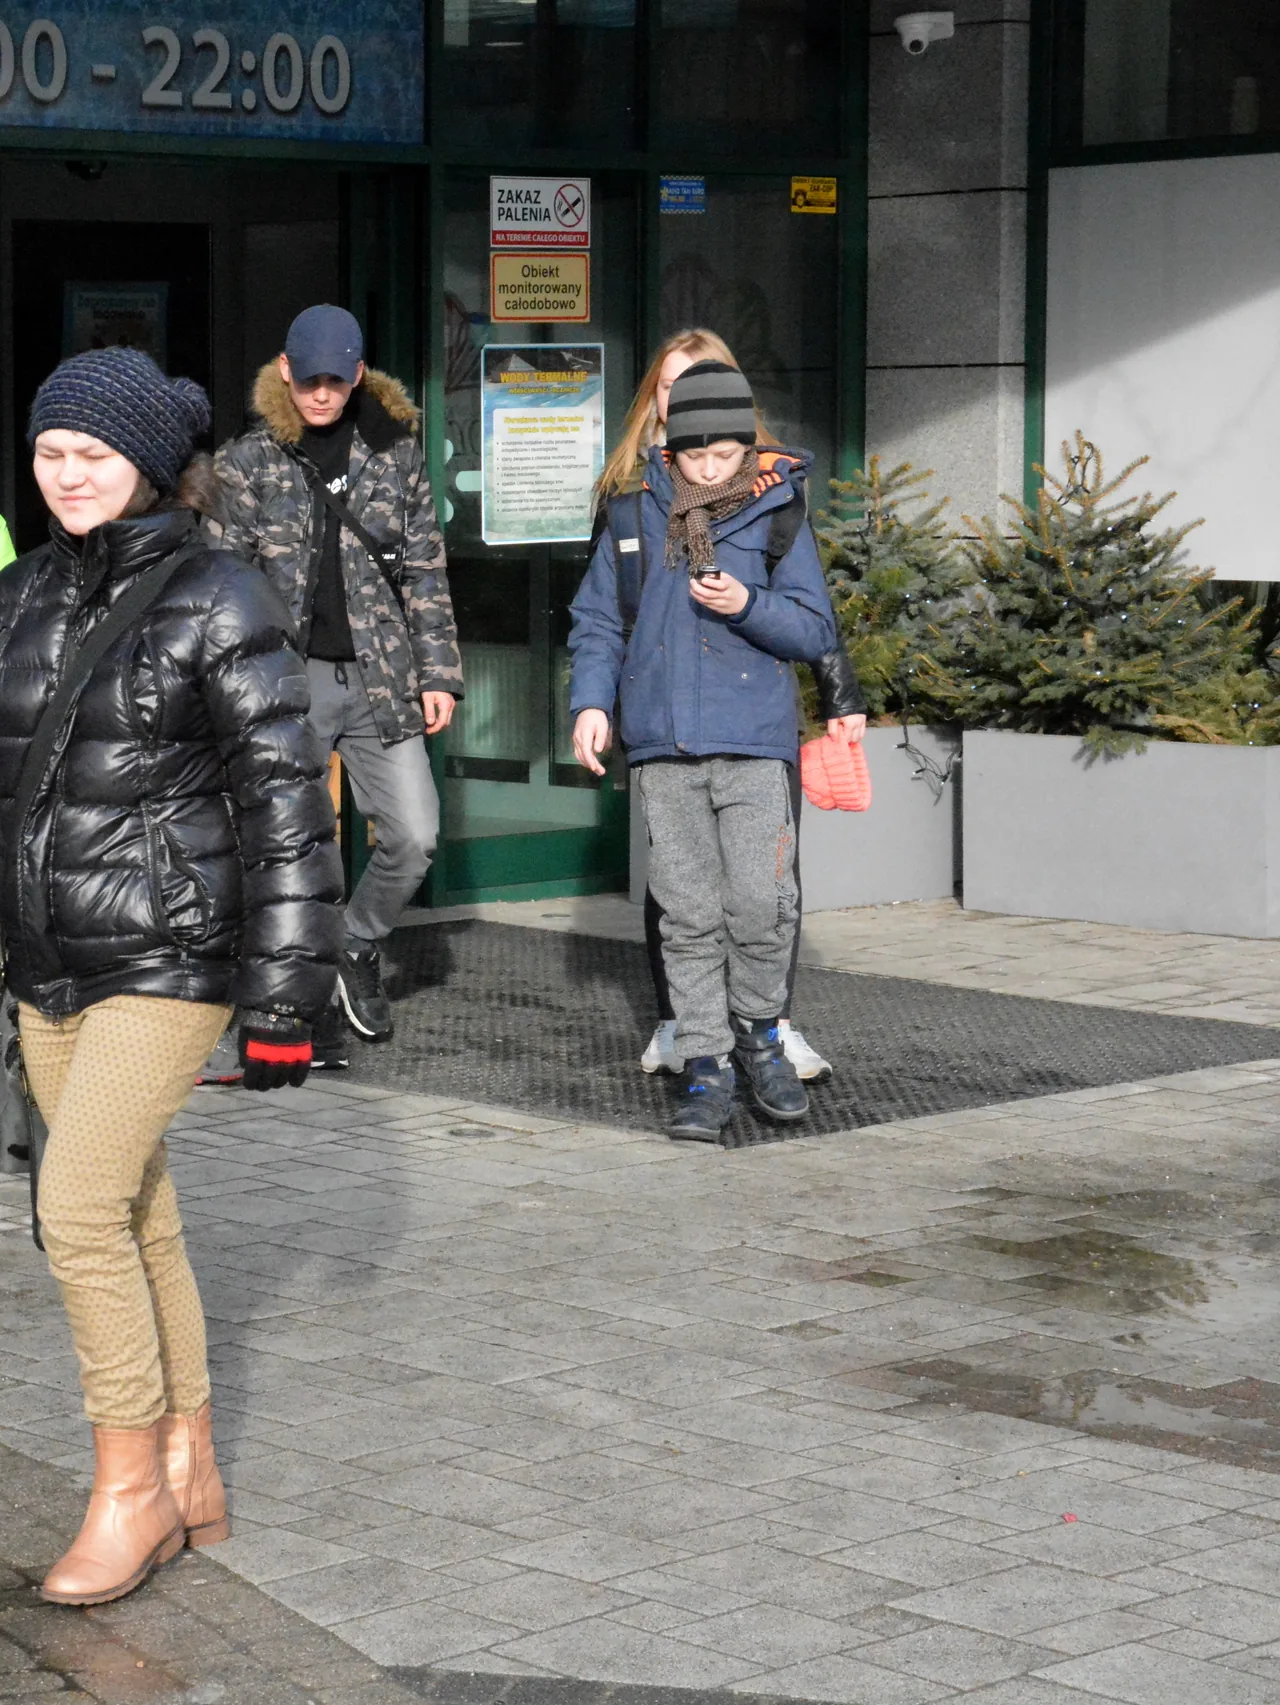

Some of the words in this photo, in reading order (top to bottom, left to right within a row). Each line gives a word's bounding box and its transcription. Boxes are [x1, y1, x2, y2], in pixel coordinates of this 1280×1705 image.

[92, 63, 116, 79] -
[141, 25, 351, 114] 22:00
[498, 190, 541, 204] ZAKAZ
[498, 207, 551, 222] PALENIA
[522, 264, 560, 278] Obiekt
[498, 281, 582, 297] monitorowany
[505, 297, 576, 310] całodobowo
[500, 372, 530, 383] WODY
[534, 371, 588, 382] TERMALNE
